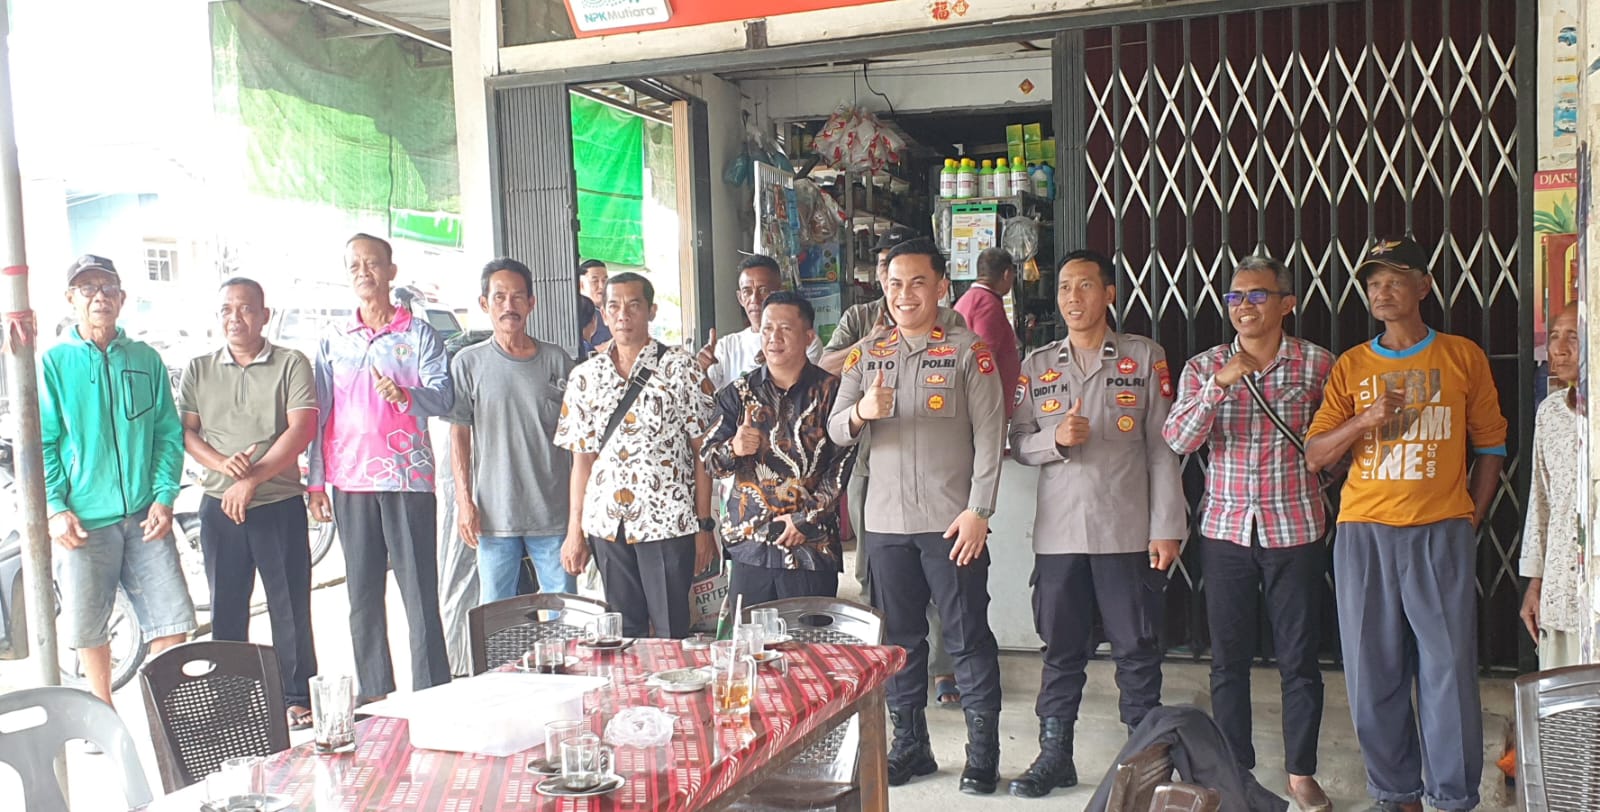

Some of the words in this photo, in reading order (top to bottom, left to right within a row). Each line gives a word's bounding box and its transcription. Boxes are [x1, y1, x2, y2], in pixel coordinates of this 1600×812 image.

[867, 360, 895, 371] RIO
[921, 358, 956, 369] POLRI
[1106, 377, 1145, 387] POLRI
[1033, 385, 1058, 397] DIDIT
[1061, 383, 1069, 392] H
[1427, 443, 1438, 458] SC
[1378, 443, 1424, 480] NE
[1426, 460, 1437, 478] 400
